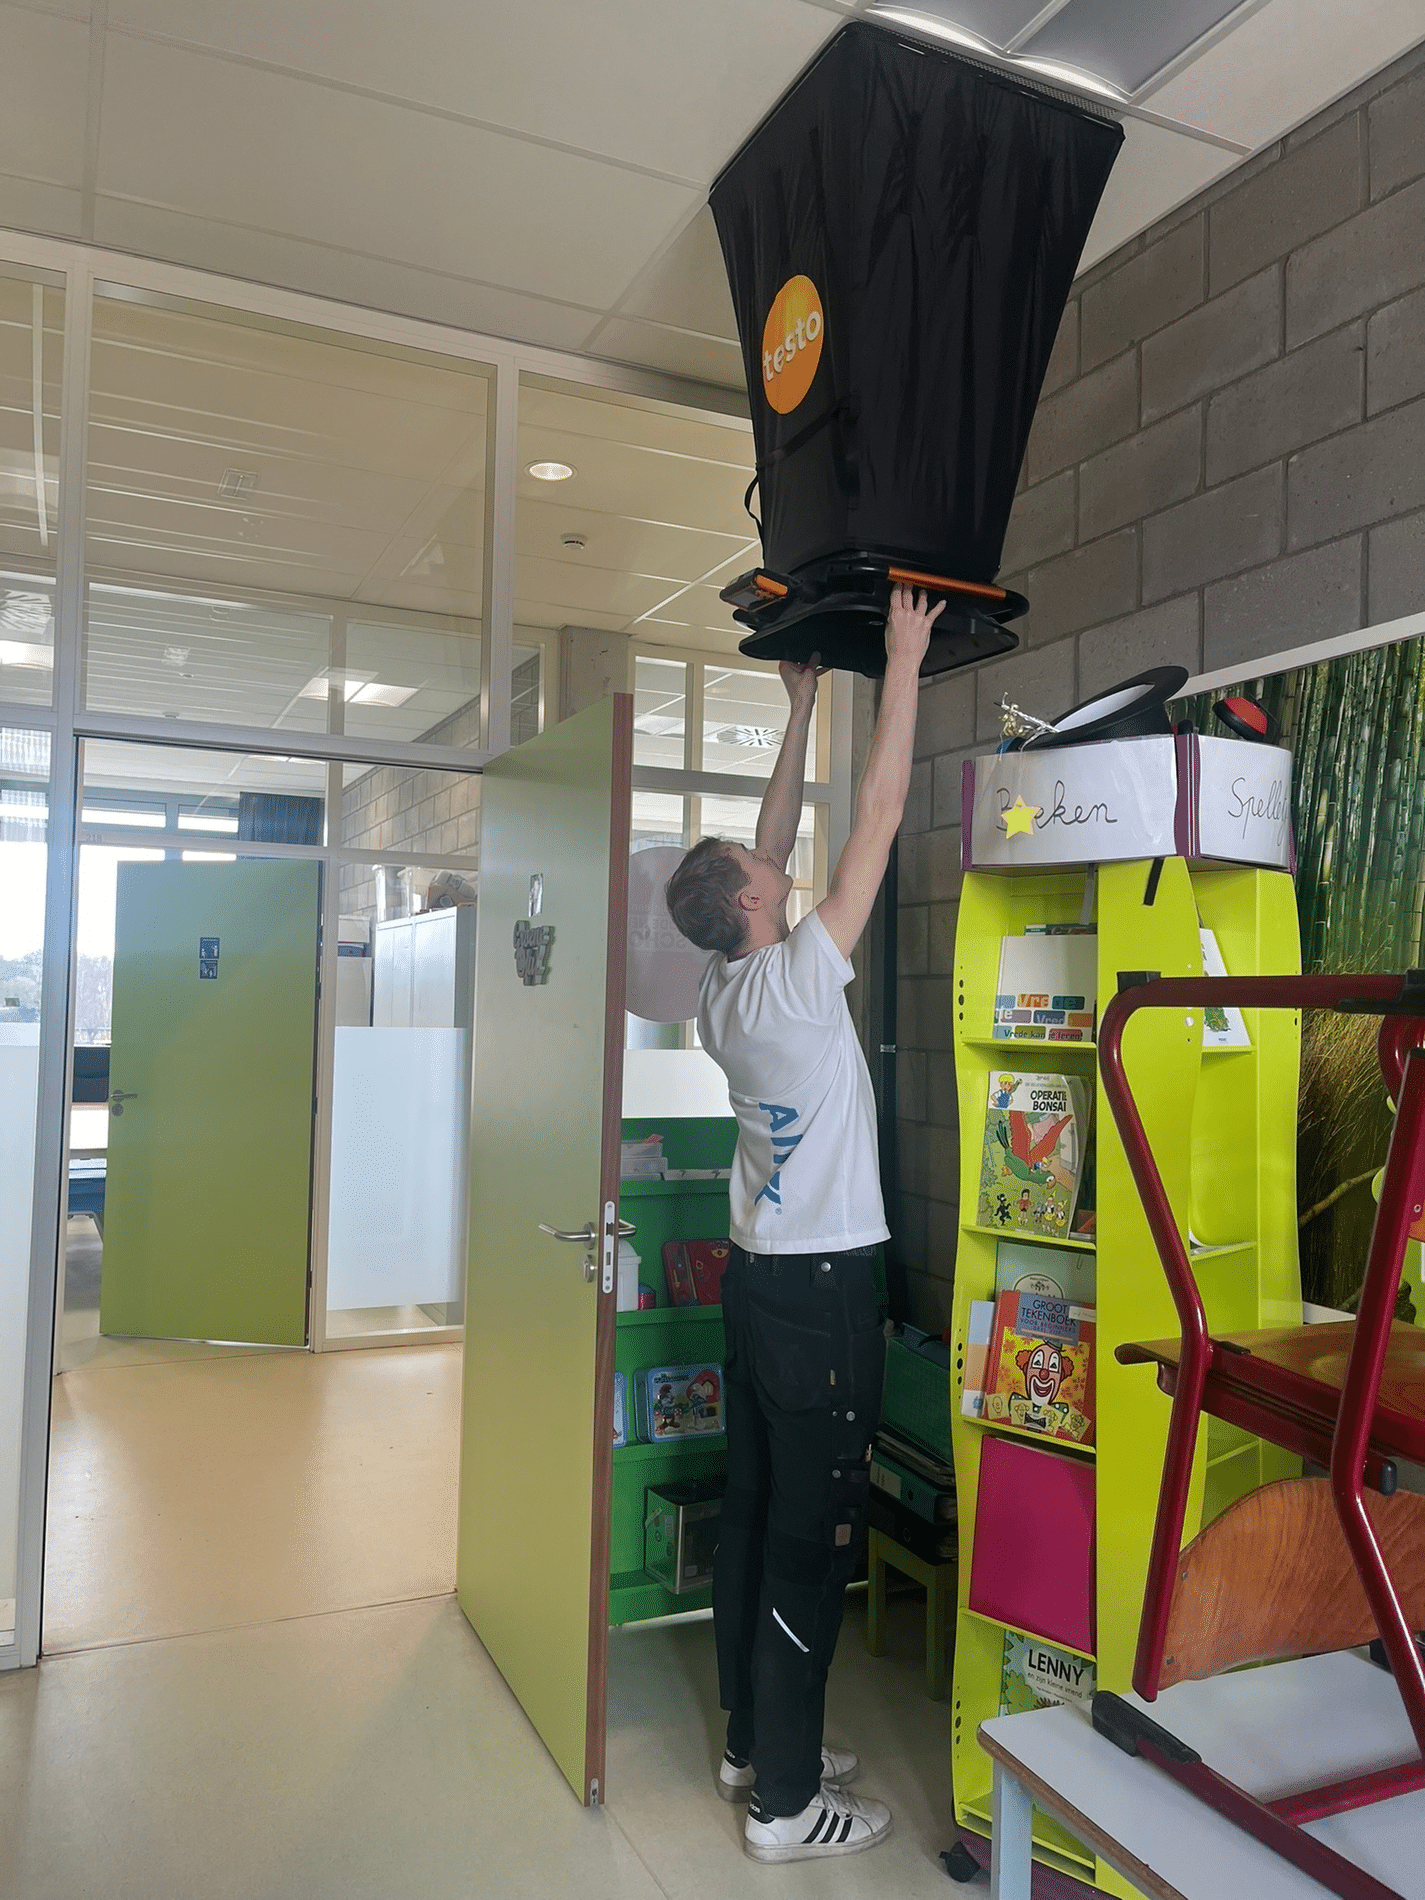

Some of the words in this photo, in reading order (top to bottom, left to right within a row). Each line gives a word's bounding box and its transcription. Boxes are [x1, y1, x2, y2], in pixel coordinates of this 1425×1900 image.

[762, 310, 822, 382] testo
[996, 779, 1118, 832] Beken
[1004, 1029, 1029, 1039] Vrede
[1031, 1030, 1046, 1039] kan
[1033, 1101, 1066, 1112] BONSAI
[1032, 1299, 1067, 1314] GROOT
[1021, 1307, 1077, 1327] TEKENBOEK
[1028, 1649, 1084, 1686] LENNY
